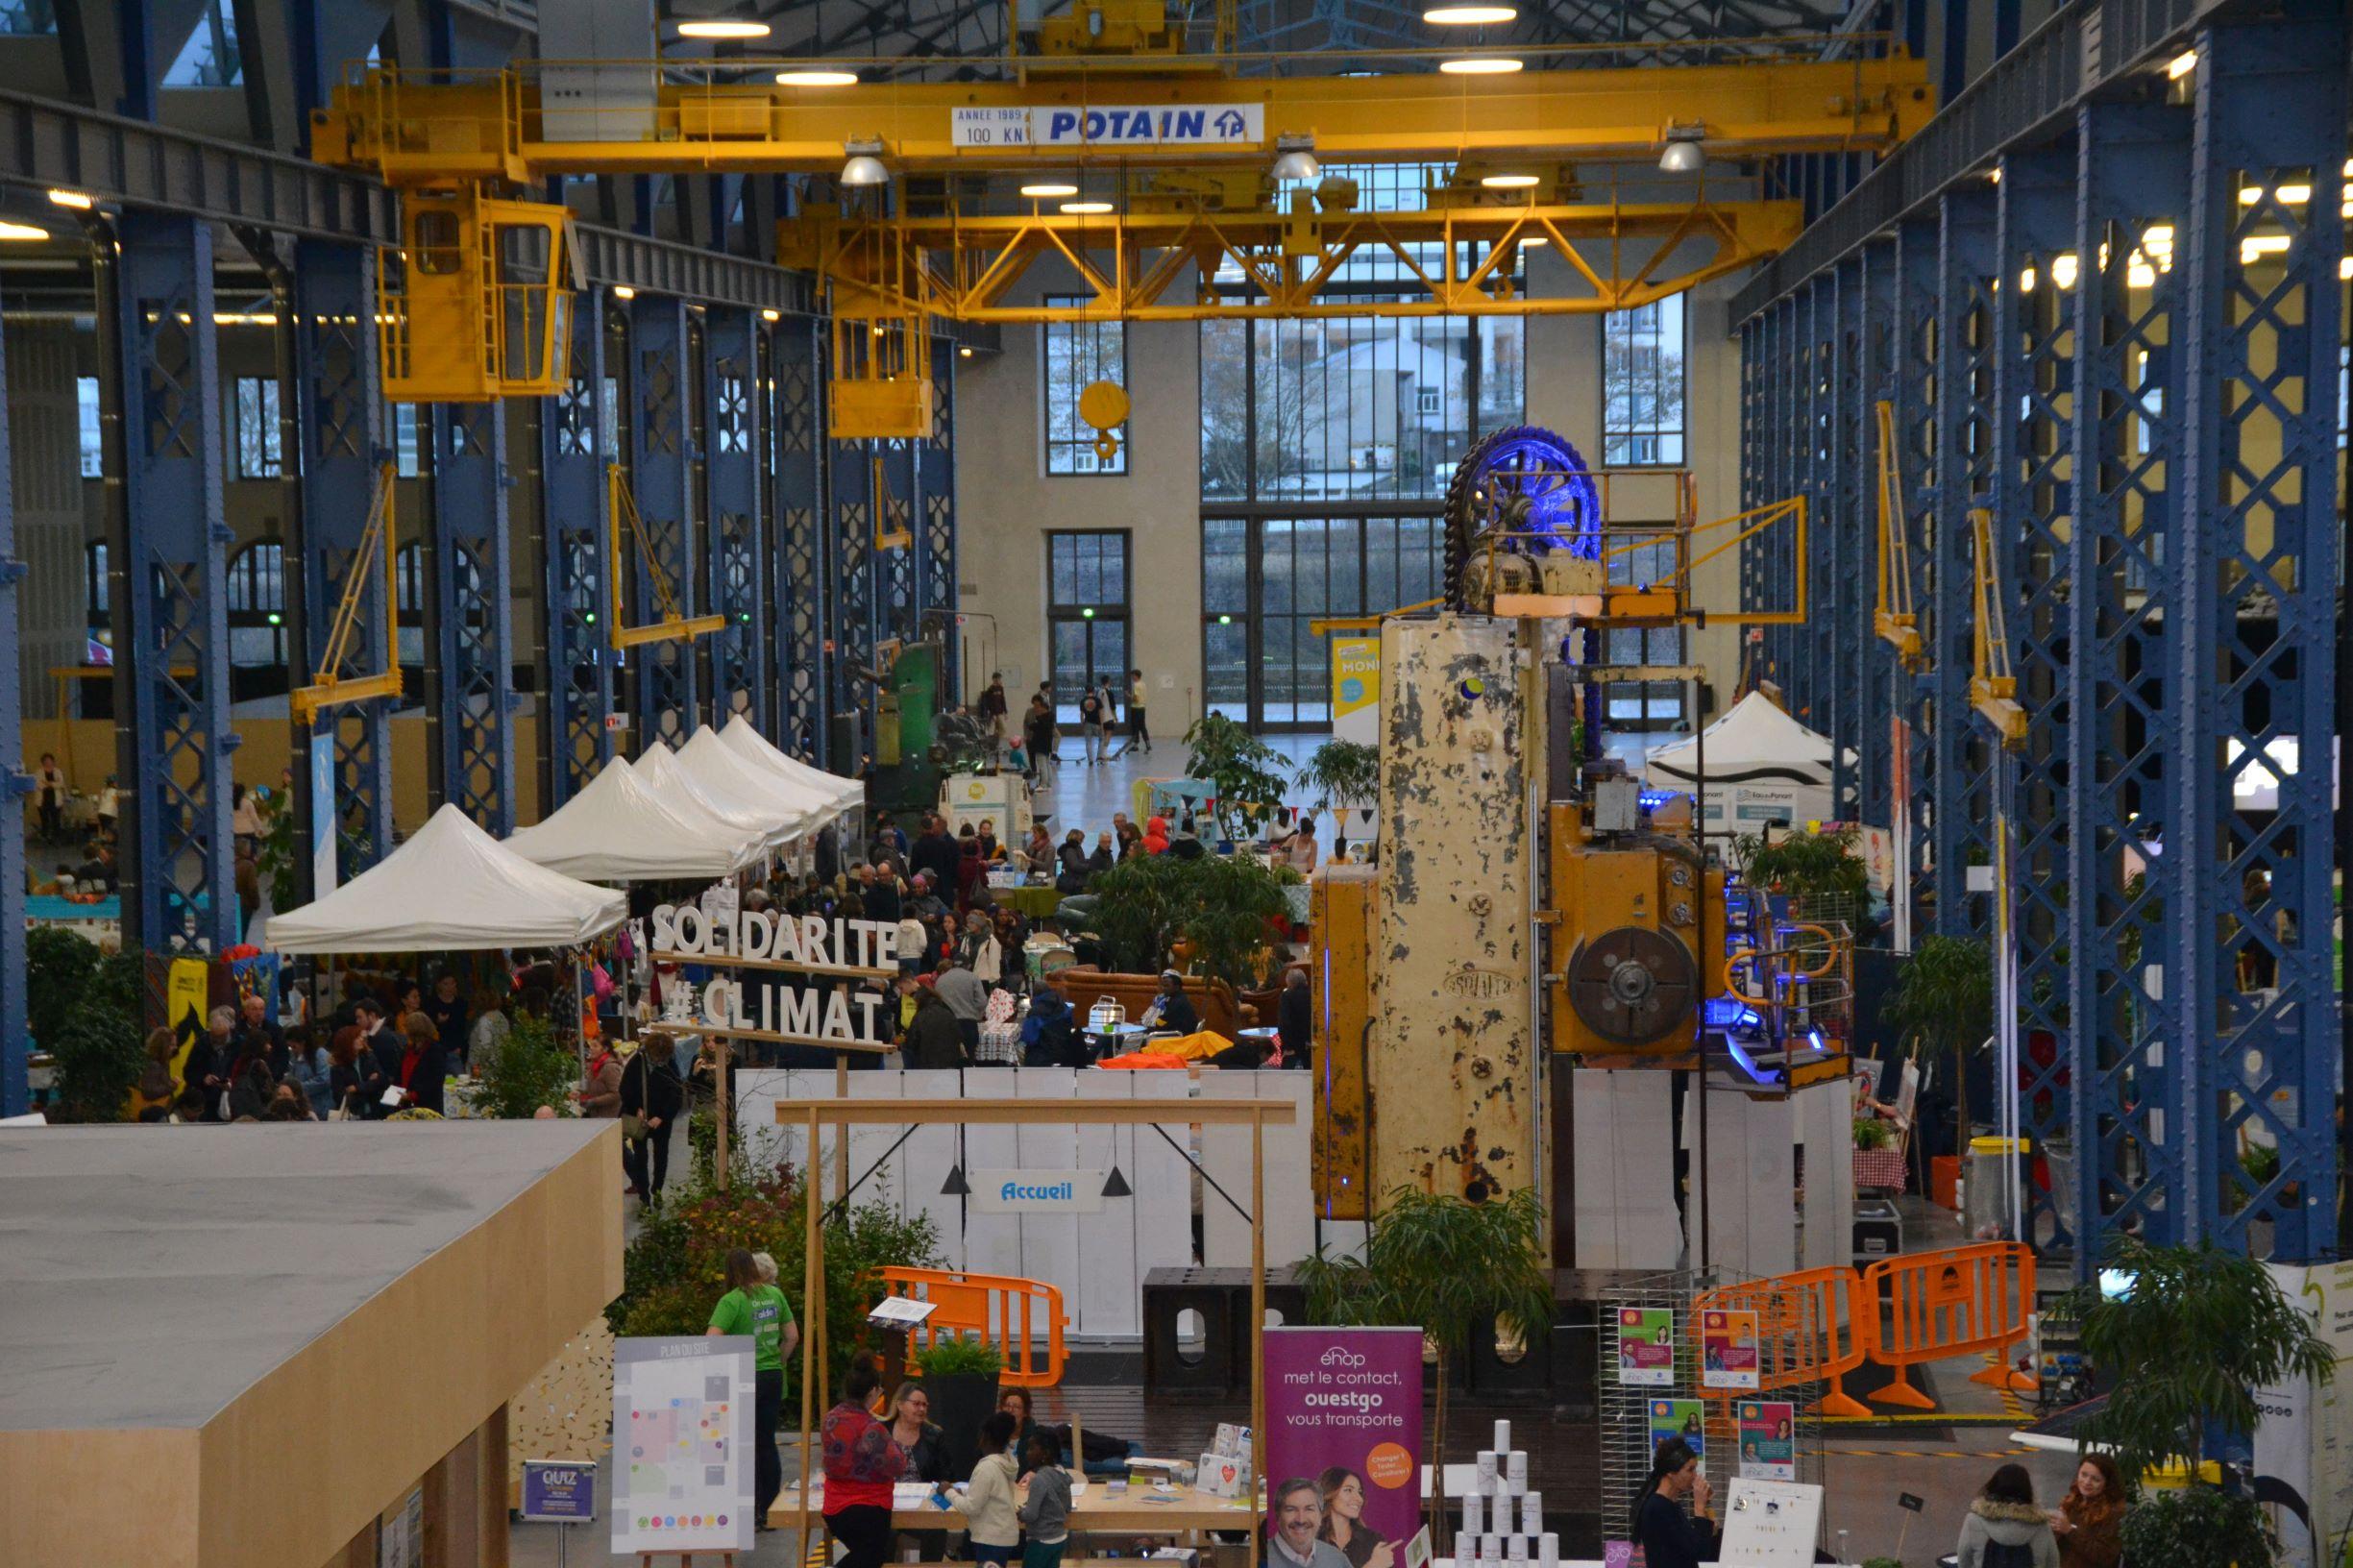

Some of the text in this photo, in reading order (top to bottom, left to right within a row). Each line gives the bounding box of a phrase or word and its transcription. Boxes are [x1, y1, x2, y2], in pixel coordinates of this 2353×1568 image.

[997, 109, 1022, 121] 1989
[1049, 110, 1206, 140] POTAIN
[966, 127, 1023, 143] 100 KN
[1000, 1182, 1072, 1200] Accueil
[660, 1341, 711, 1358] PLAN DU SITE
[1284, 1371, 1403, 1385] met le contact,
[1305, 1392, 1383, 1412] ouestgo
[1287, 1412, 1404, 1429] vous transporte
[542, 1470, 577, 1486] QUIZ
